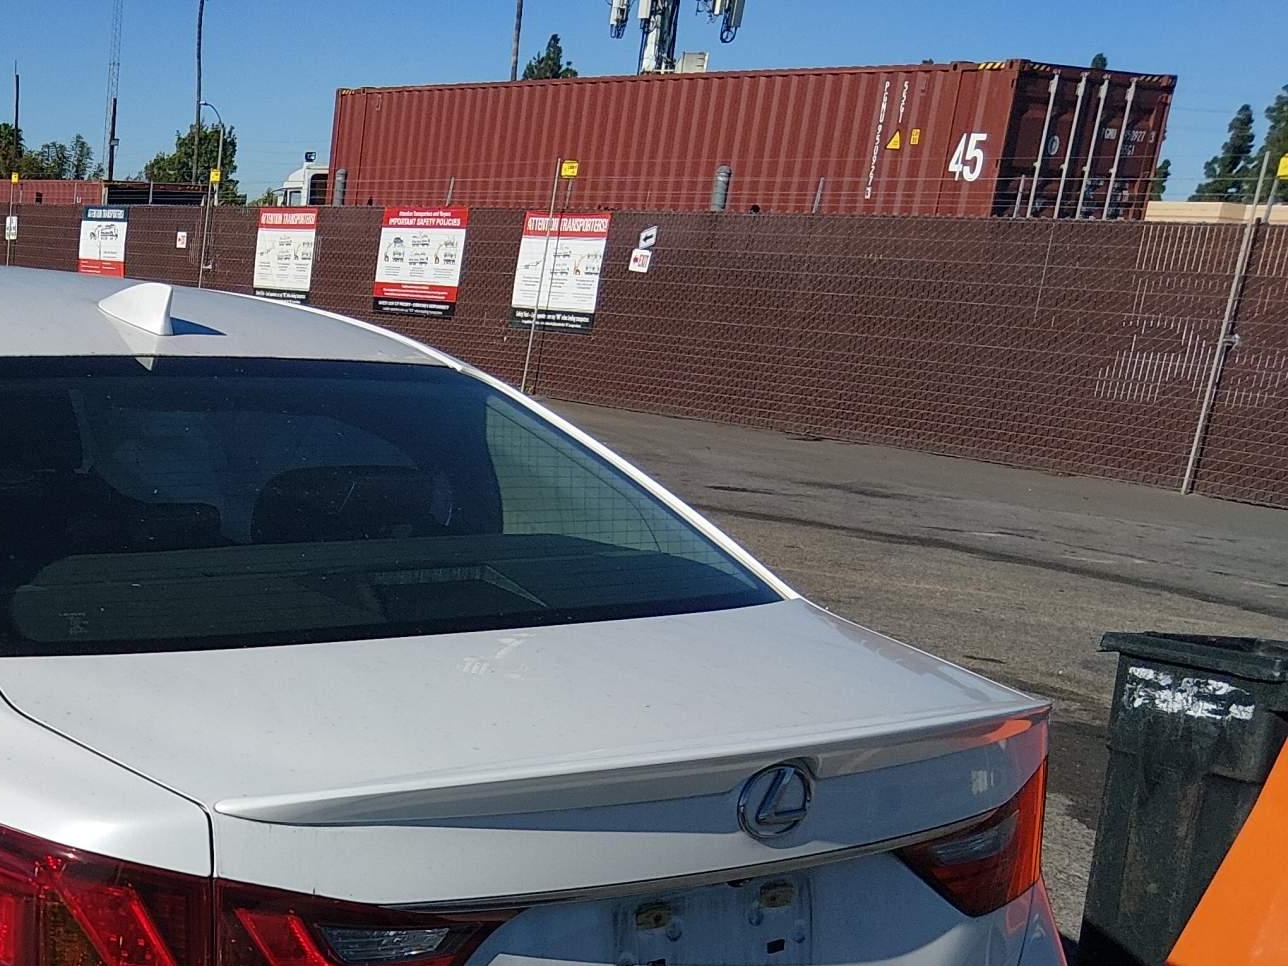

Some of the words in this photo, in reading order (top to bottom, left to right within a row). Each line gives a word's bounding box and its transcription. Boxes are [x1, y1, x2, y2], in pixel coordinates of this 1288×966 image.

[947, 132, 988, 182] 45
[417, 218, 436, 226] SAFETY
[436, 218, 460, 226] POLICIES
